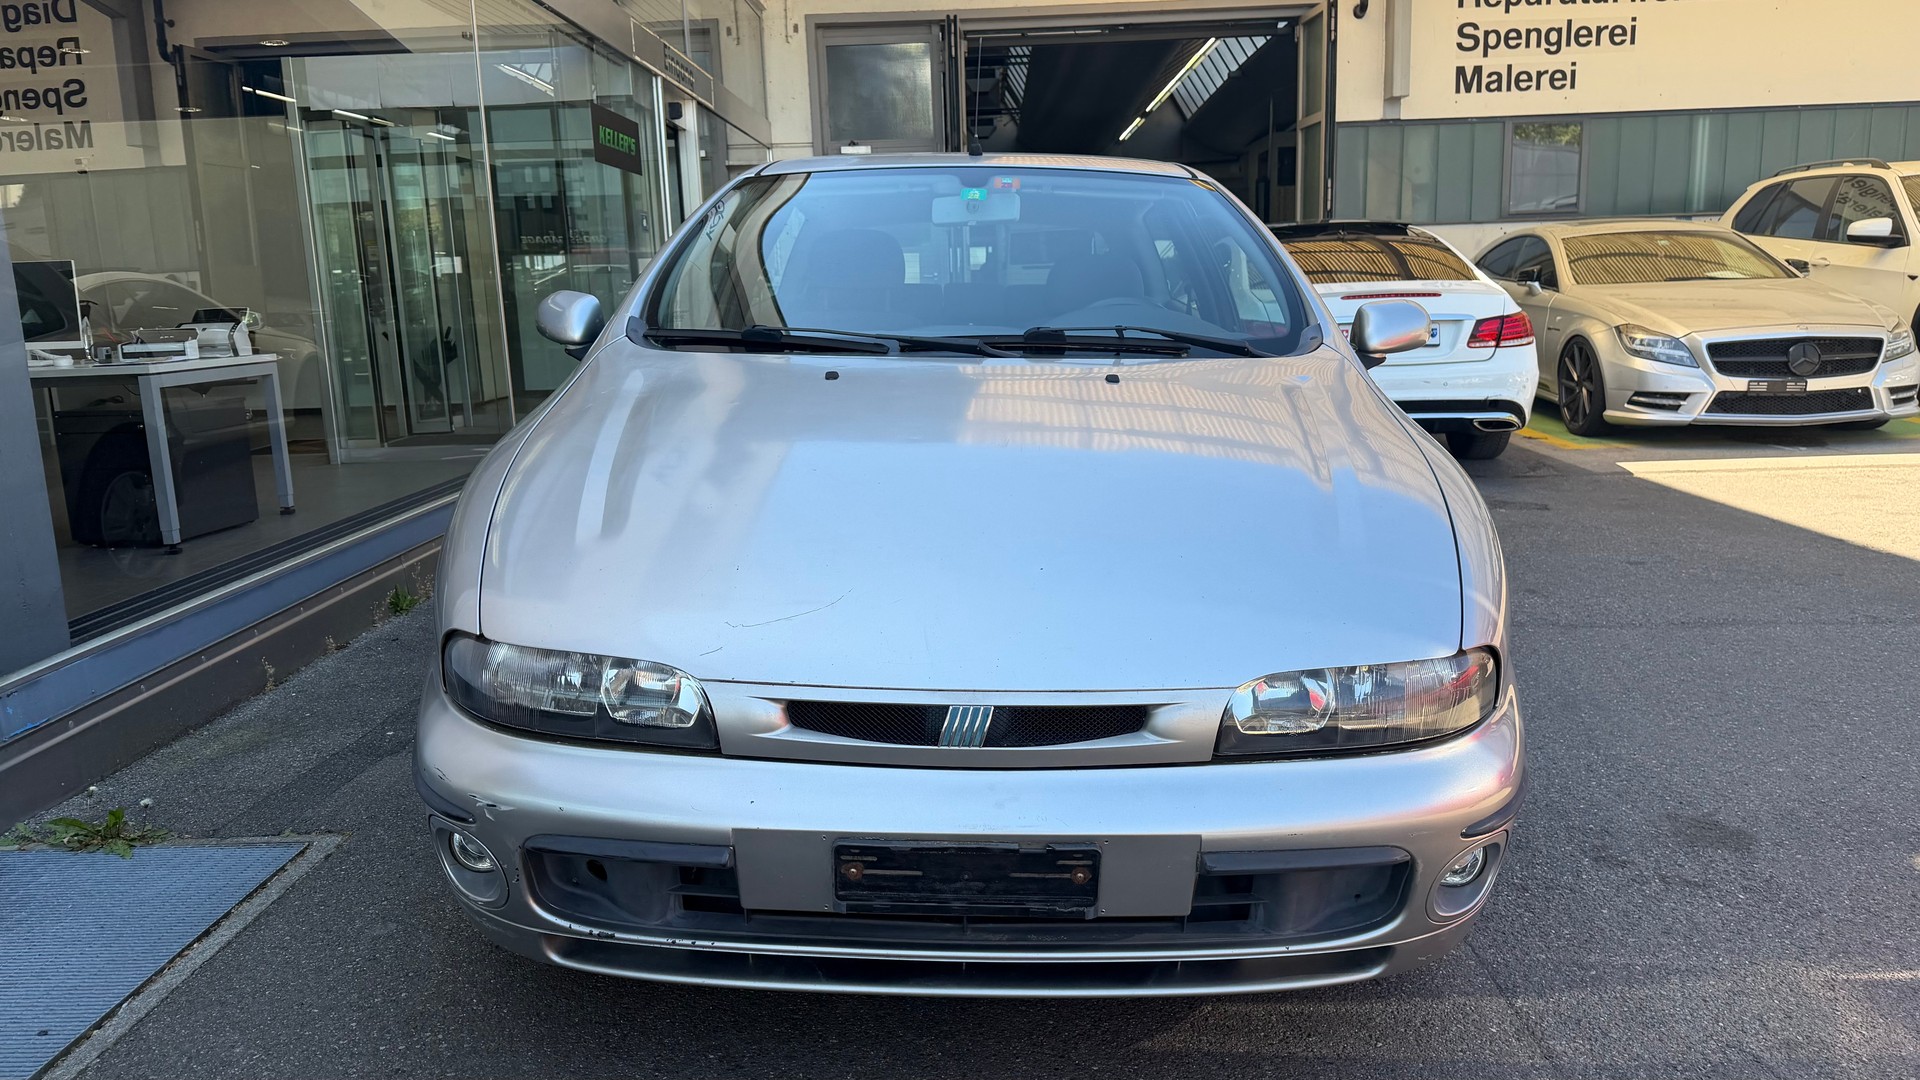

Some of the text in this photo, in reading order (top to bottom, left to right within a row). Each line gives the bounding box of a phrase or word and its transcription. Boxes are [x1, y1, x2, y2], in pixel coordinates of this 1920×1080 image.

[1456, 16, 1638, 58] Spenglerei
[1455, 62, 1577, 94] Malerei
[599, 125, 636, 156] KELLER'S
